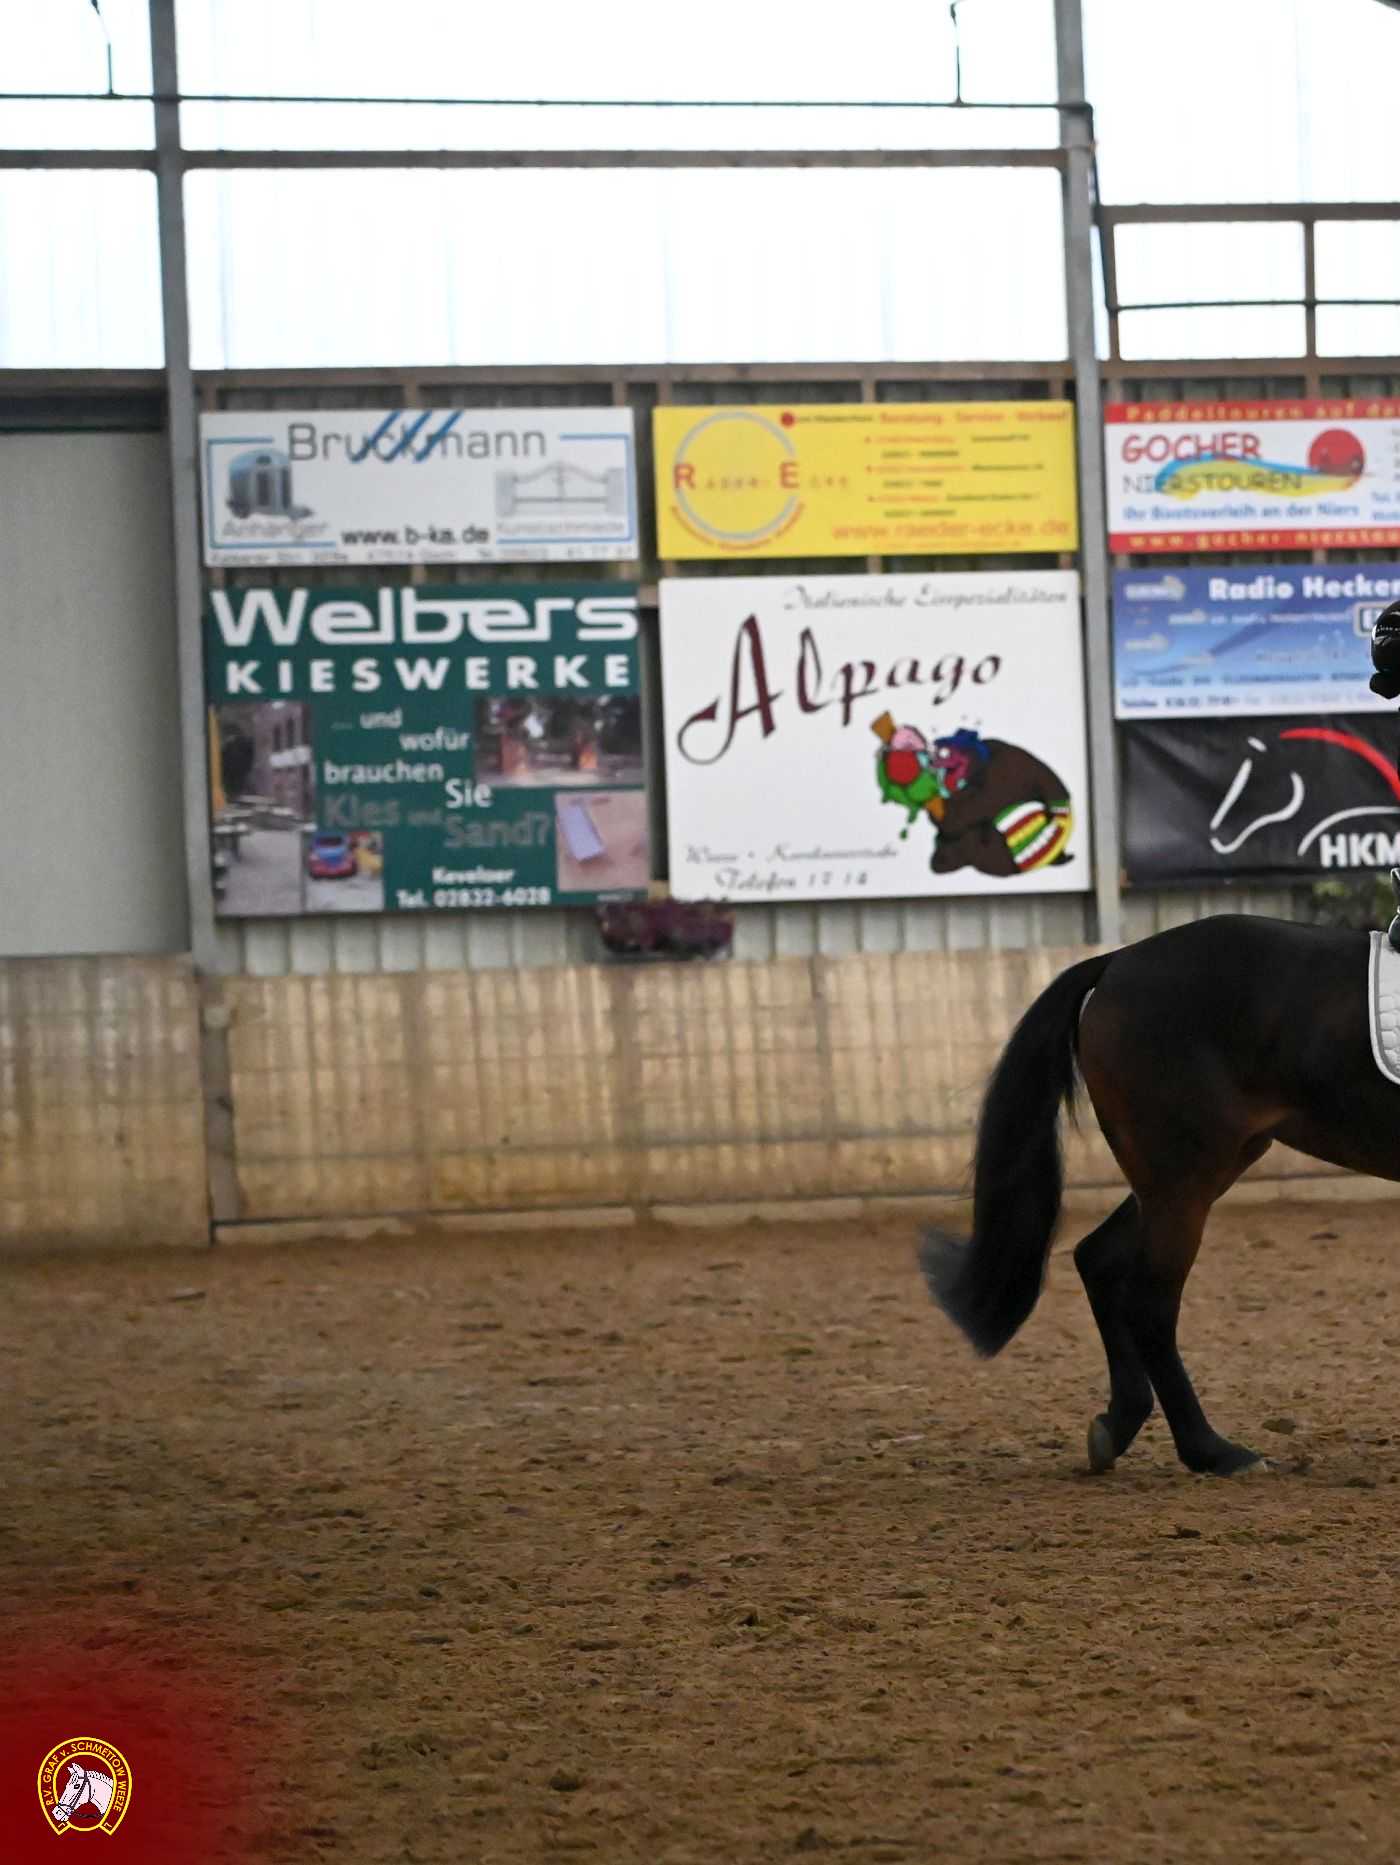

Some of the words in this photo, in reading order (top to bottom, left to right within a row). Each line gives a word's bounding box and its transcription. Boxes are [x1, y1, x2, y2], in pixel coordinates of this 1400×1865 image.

[1122, 432, 1261, 463] GOCHER
[1208, 574, 1295, 600] Radio
[210, 586, 640, 647] Welbers
[225, 654, 631, 694] KIESWERKE
[678, 612, 1003, 766] Alpago
[360, 708, 403, 730] und
[399, 726, 471, 752] wofür
[324, 760, 445, 785] brauchen
[444, 777, 494, 809] Sie
[323, 792, 400, 828] Kies
[443, 811, 551, 848] Sand?
[396, 888, 429, 908] Tel.
